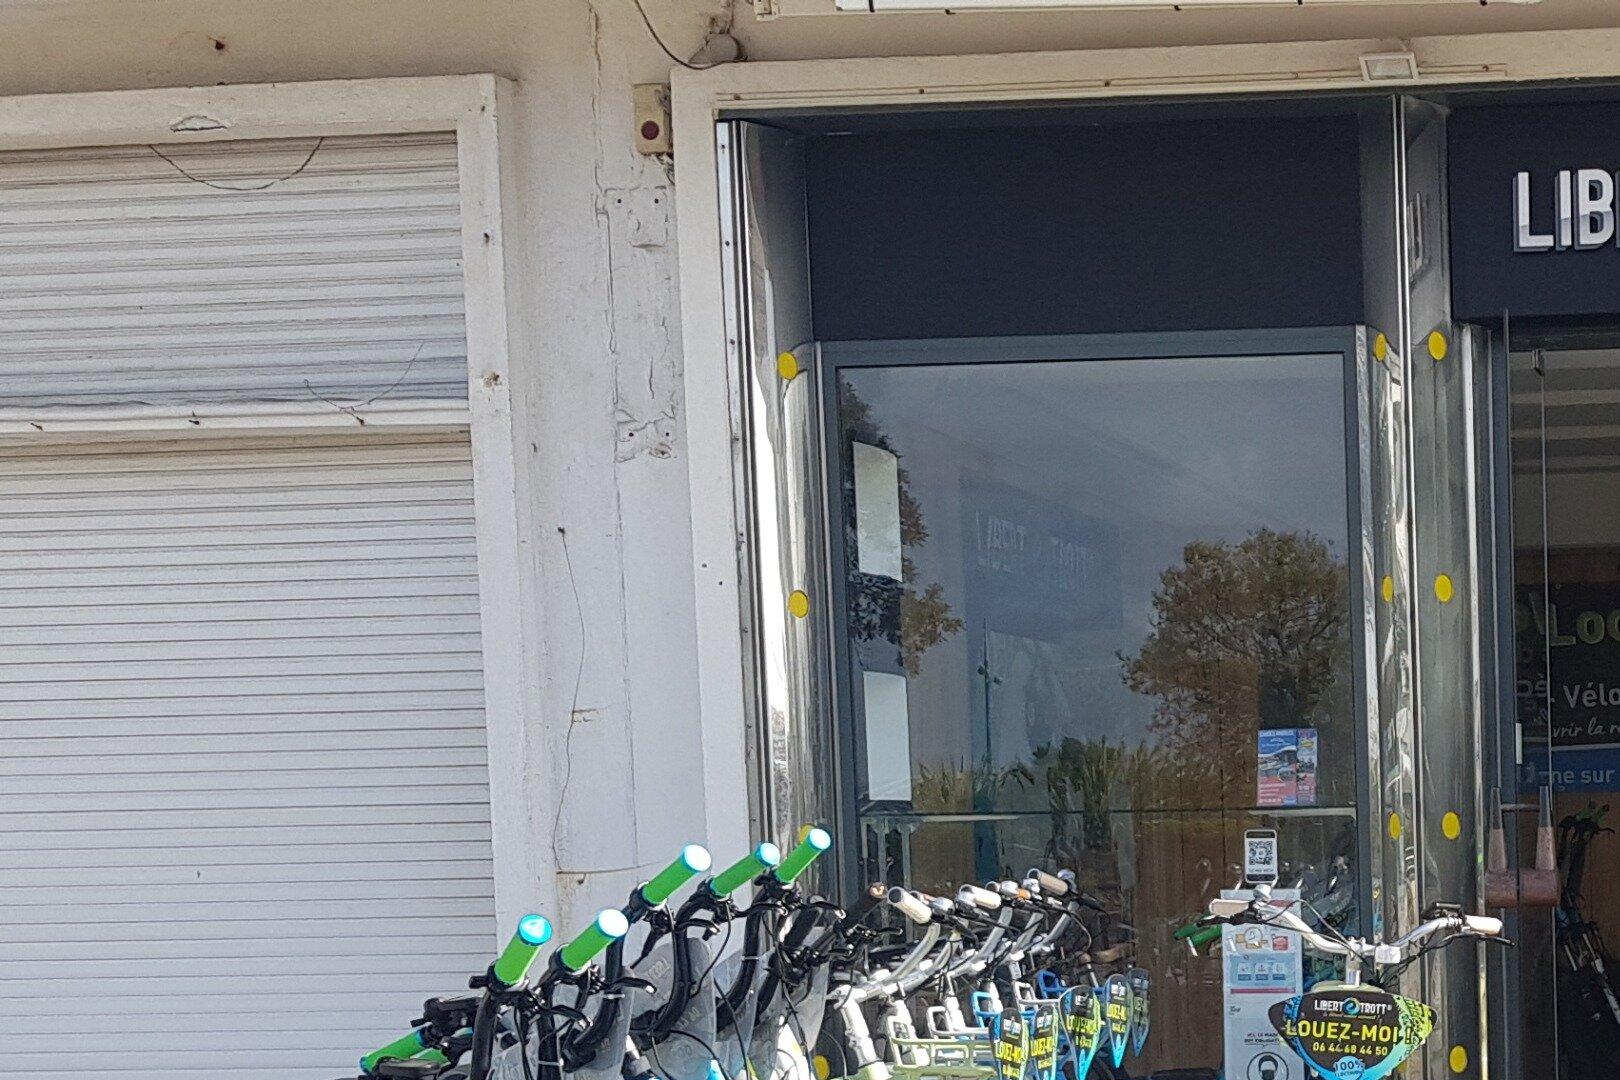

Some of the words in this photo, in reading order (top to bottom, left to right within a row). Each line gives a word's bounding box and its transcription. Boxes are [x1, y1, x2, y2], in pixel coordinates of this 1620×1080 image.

[1551, 719, 1584, 739] vrir
[1588, 716, 1605, 736] la
[1580, 769, 1616, 784] sur
[1314, 999, 1343, 1012] LIBERT
[1359, 1003, 1387, 1014] TROTT
[1286, 1019, 1398, 1043] LOUEZ-MOI
